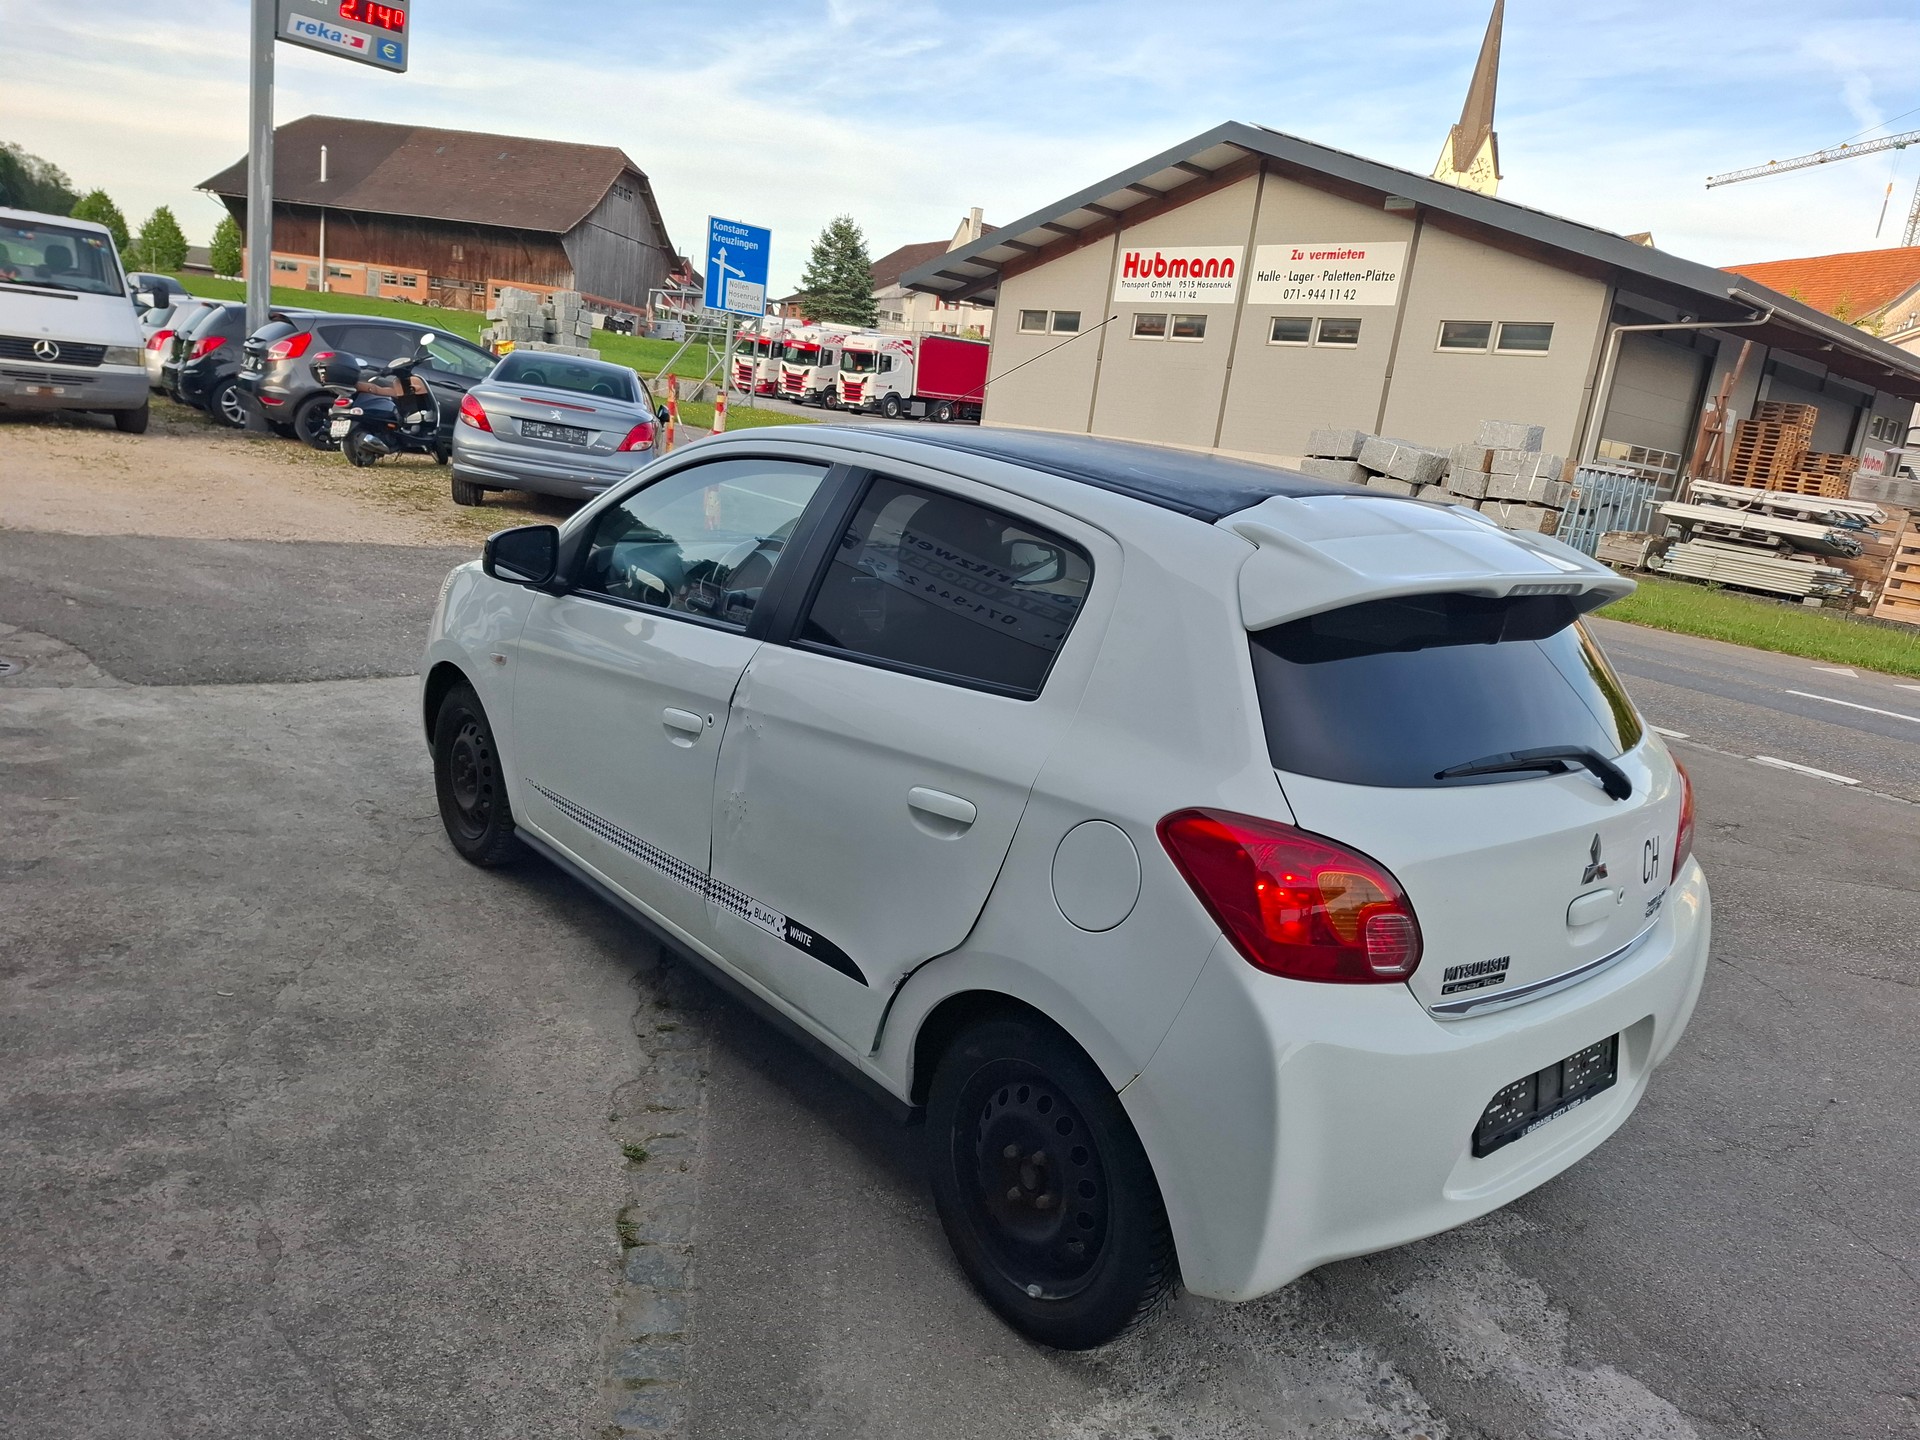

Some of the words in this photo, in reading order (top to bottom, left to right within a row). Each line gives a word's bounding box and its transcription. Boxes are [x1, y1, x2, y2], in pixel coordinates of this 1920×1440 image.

[713, 220, 749, 237] Konstanz
[712, 232, 758, 251] Kreuzlingen
[1290, 249, 1304, 260] Zu
[1309, 248, 1365, 260] vermieten
[1123, 252, 1235, 278] Hubmann
[1257, 270, 1281, 281] Halle
[1288, 270, 1314, 284] Lager
[1322, 269, 1396, 282] Paletten-Plätze
[1121, 281, 1150, 291] Transport
[1197, 281, 1232, 289] Hosenruck
[728, 290, 760, 301] Hosenruck
[1329, 289, 1341, 300] 11
[1343, 289, 1357, 300] 42
[728, 299, 761, 311] Wuppenau
[1642, 835, 1660, 885] CH
[754, 907, 776, 927] BLACK
[775, 915, 787, 941] &
[790, 926, 812, 947] WHITE
[1527, 1114, 1553, 1133] GARAGE
[1552, 1106, 1567, 1120] CITY
